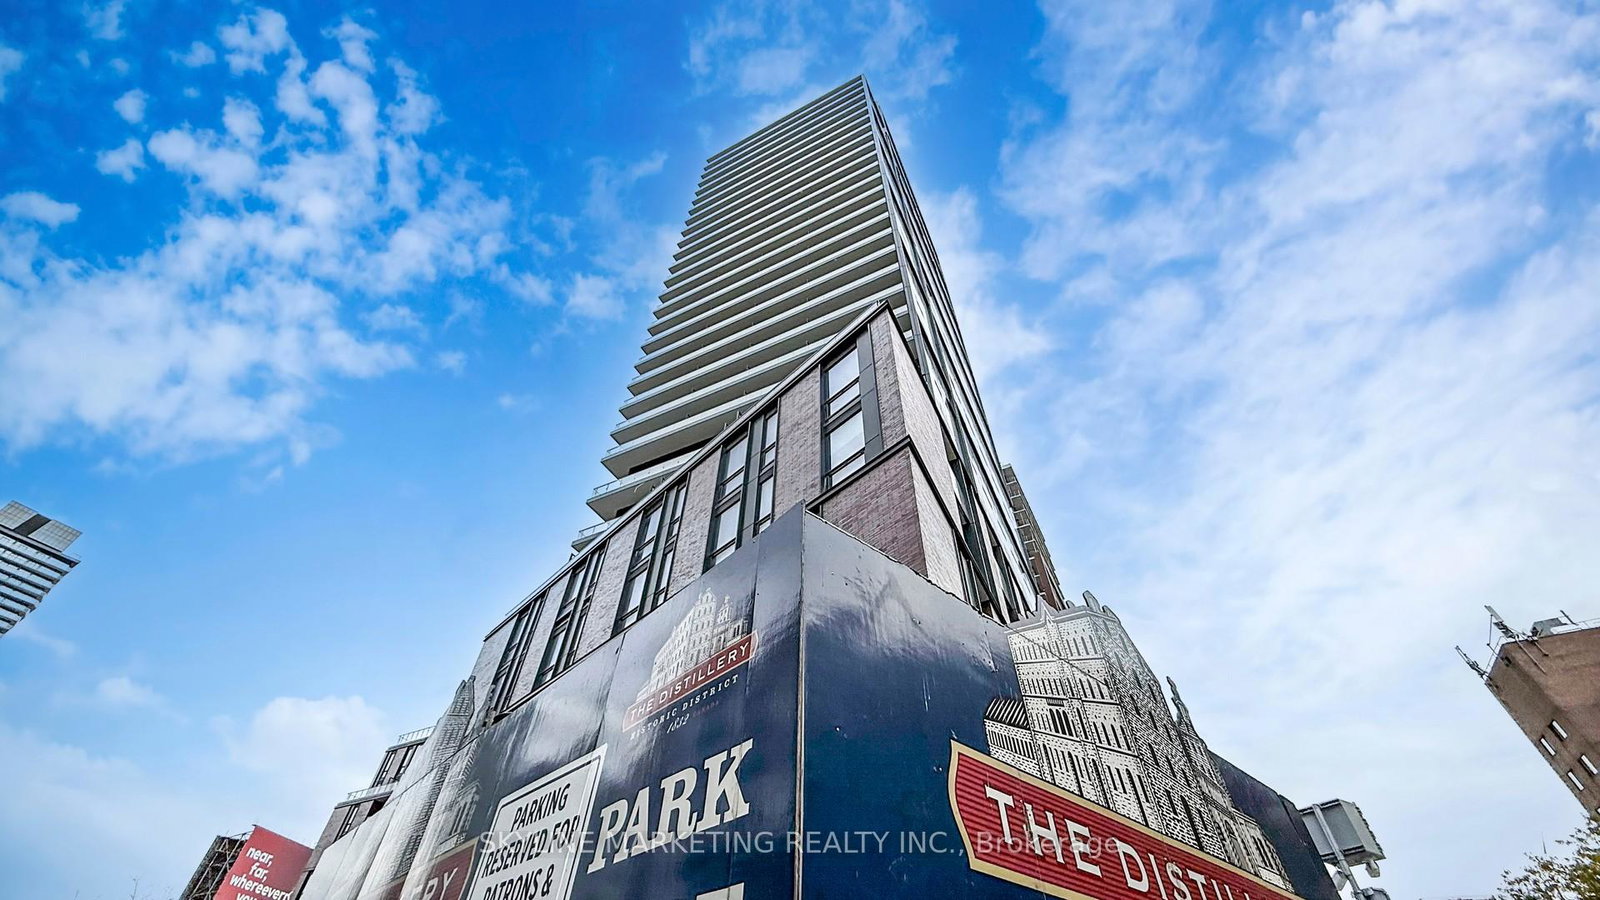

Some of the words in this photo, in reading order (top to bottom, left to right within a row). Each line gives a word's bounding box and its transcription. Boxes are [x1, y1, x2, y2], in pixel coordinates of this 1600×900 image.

[629, 697, 655, 721] THE
[658, 641, 750, 705] DISTILLERY
[629, 708, 678, 741] HISTORIC
[681, 674, 739, 711] DISTRICT
[509, 783, 571, 833] PARKING
[586, 738, 754, 875] PARK
[984, 783, 1103, 879] THE
[246, 846, 274, 868] near,
[249, 862, 270, 883] far,
[480, 828, 549, 879] RESERVED
[547, 814, 581, 854] FOR
[540, 863, 555, 898] &
